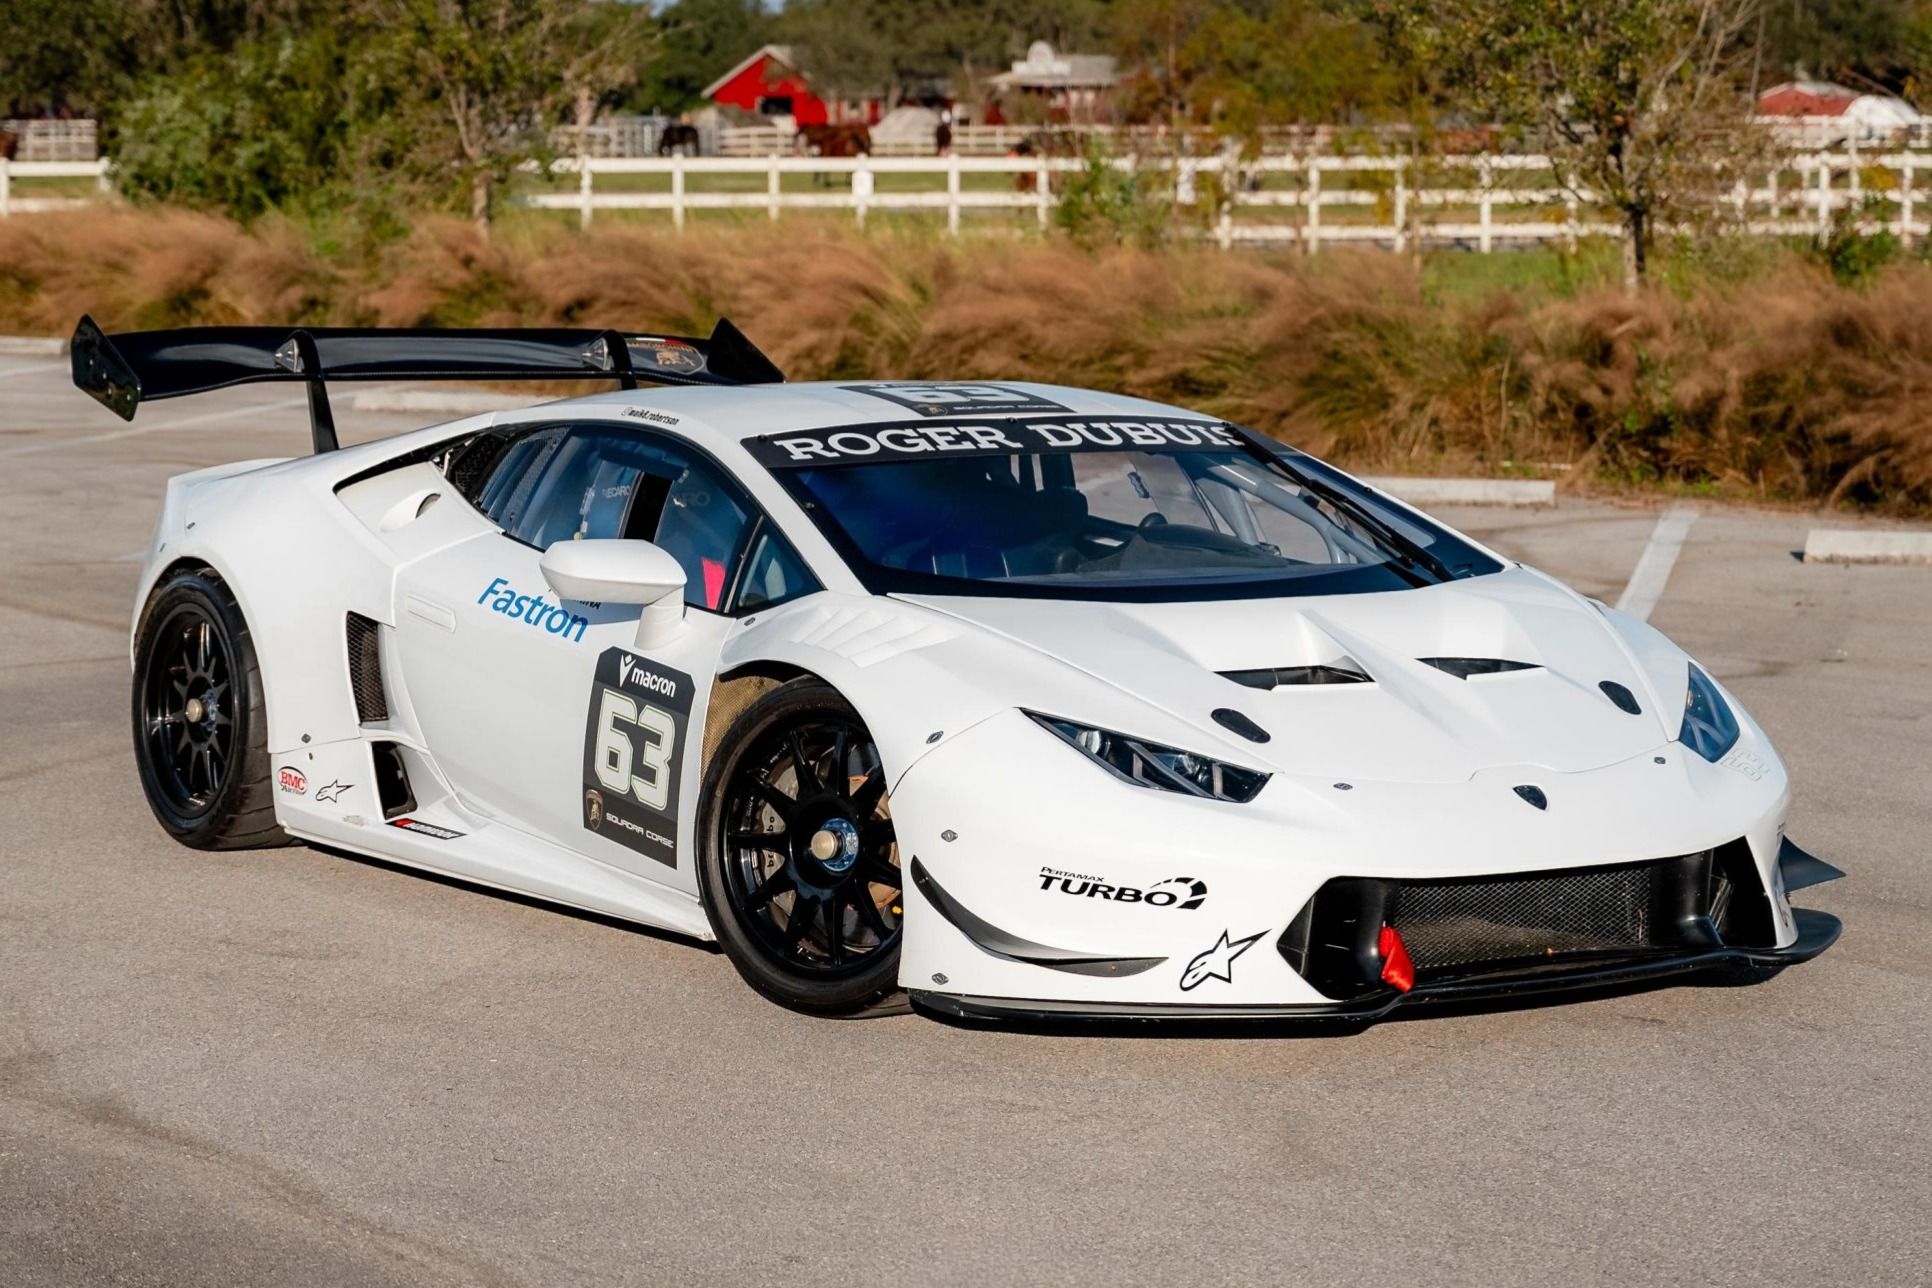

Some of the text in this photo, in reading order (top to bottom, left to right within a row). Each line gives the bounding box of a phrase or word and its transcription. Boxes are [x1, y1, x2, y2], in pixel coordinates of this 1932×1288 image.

[870, 386, 1030, 403] 63
[774, 425, 1024, 461] ROGER
[478, 577, 589, 642] Fastron
[631, 667, 676, 698] macron
[594, 688, 676, 811] 63
[281, 771, 305, 791] BMC
[606, 812, 674, 849] SQUADRA CORSE
[1039, 874, 1178, 906] TURBO
[1041, 866, 1105, 882] PERTAMAX
